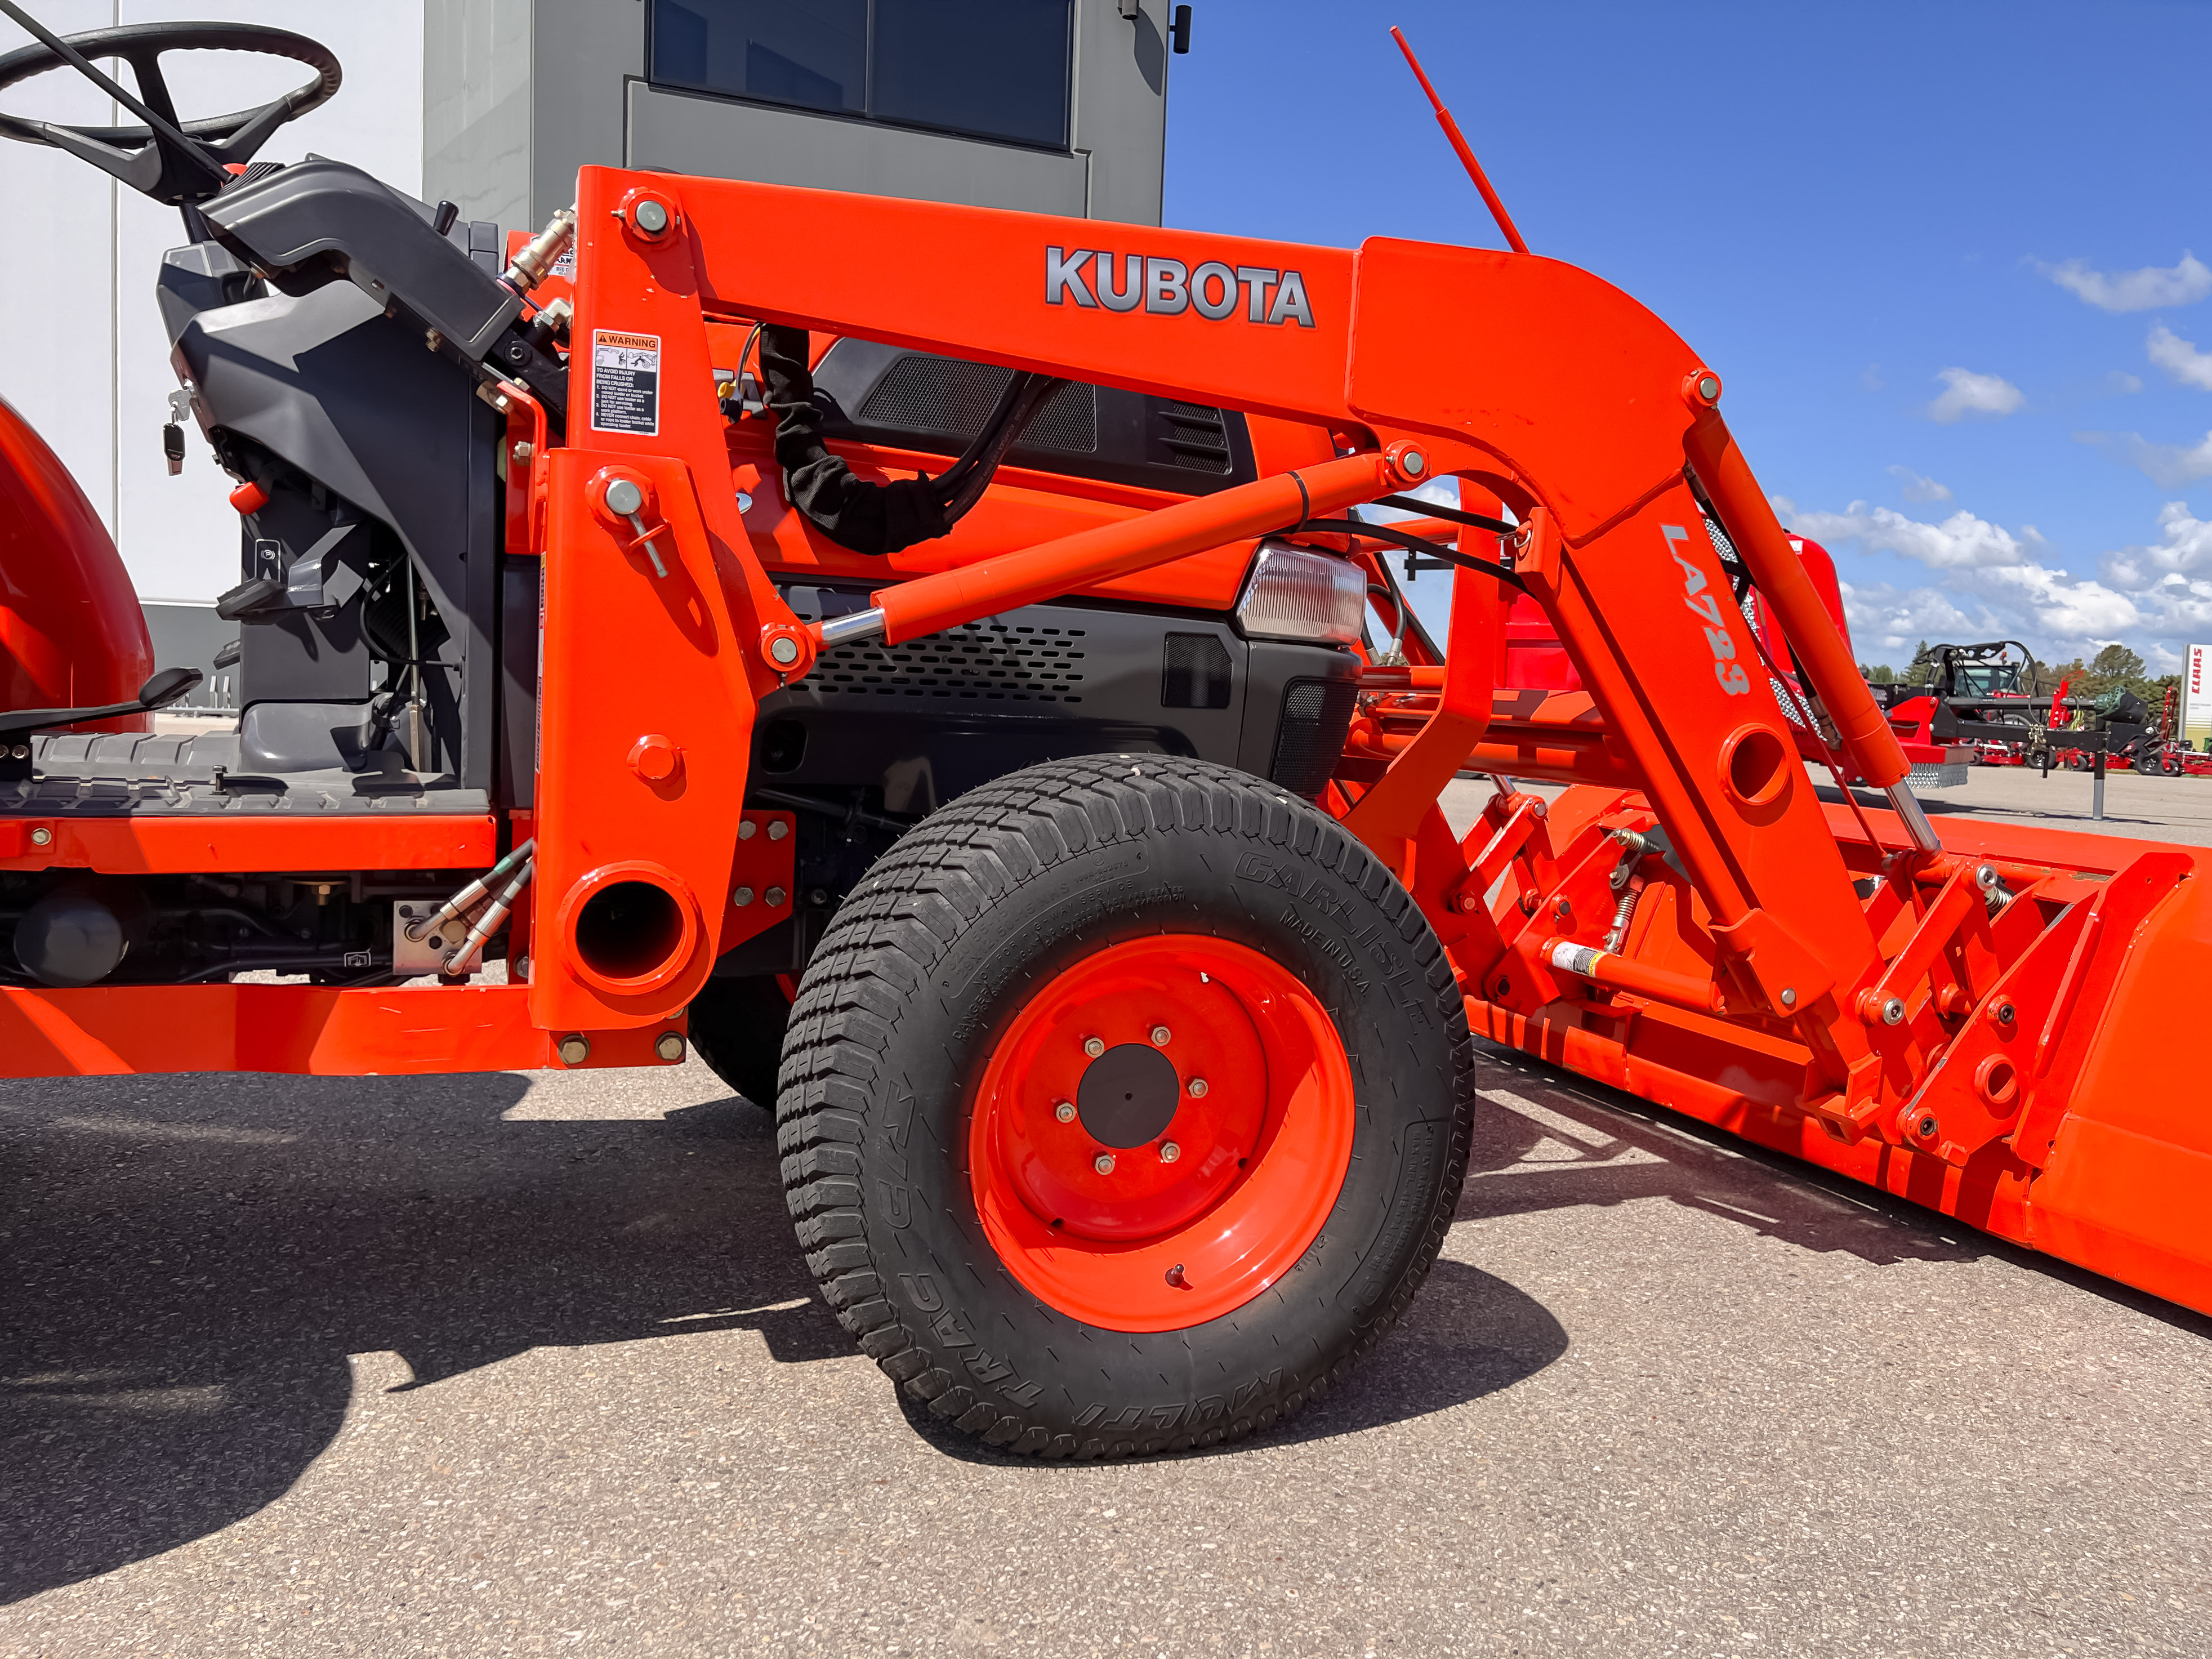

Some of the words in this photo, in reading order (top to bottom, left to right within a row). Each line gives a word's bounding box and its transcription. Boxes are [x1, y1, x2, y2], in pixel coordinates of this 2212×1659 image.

[1045, 245, 1317, 328] KUBOTA
[609, 336, 655, 348] WARNING
[1659, 524, 1750, 696] LA723
[2192, 648, 2202, 694] CLAAS
[972, 964, 994, 987] NOT
[996, 940, 1017, 961] FOR
[1080, 881, 1133, 904] SERVICE
[1235, 851, 1434, 1035] CARLISLE
[1279, 909, 1325, 946] MADE
[1322, 938, 1341, 958] IN
[899, 1273, 1046, 1410] TRAC
[1073, 1367, 1284, 1429] MULTI
